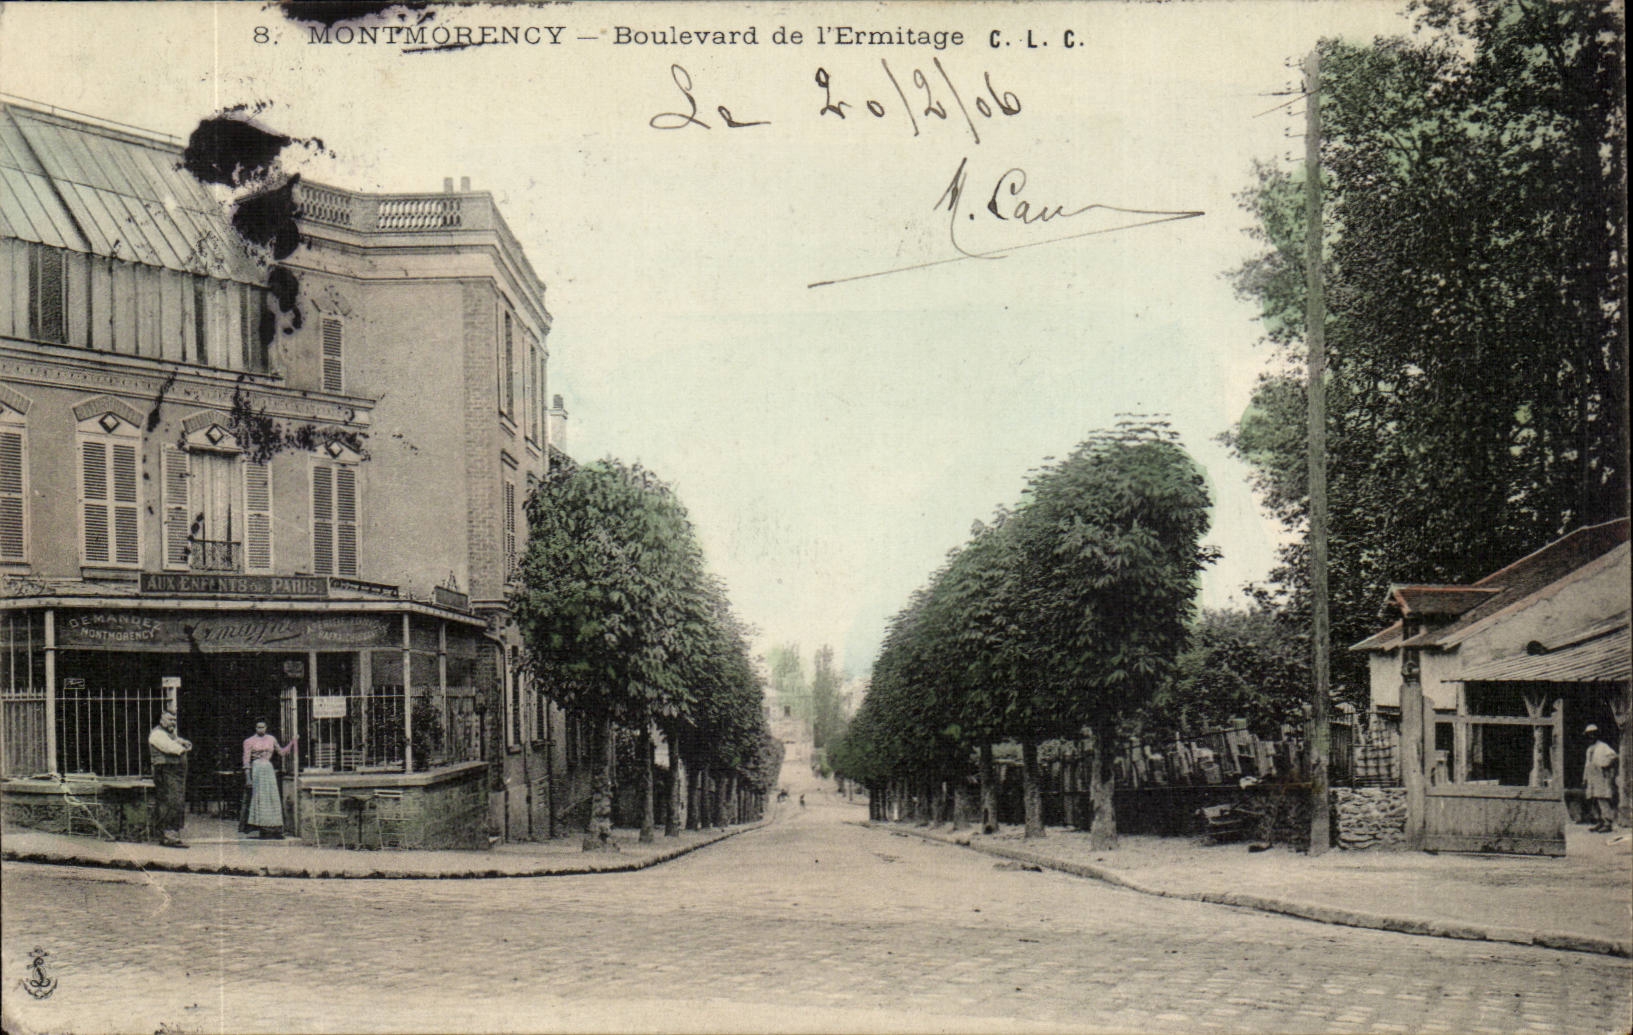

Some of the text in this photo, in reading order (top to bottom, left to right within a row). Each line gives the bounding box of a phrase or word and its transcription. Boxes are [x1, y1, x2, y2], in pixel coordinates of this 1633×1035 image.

[650, 64, 771, 129] Le
[146, 574, 175, 591] AUX
[68, 614, 161, 631] DEMANDEZ
[80, 627, 155, 641] MONTMORENCY
